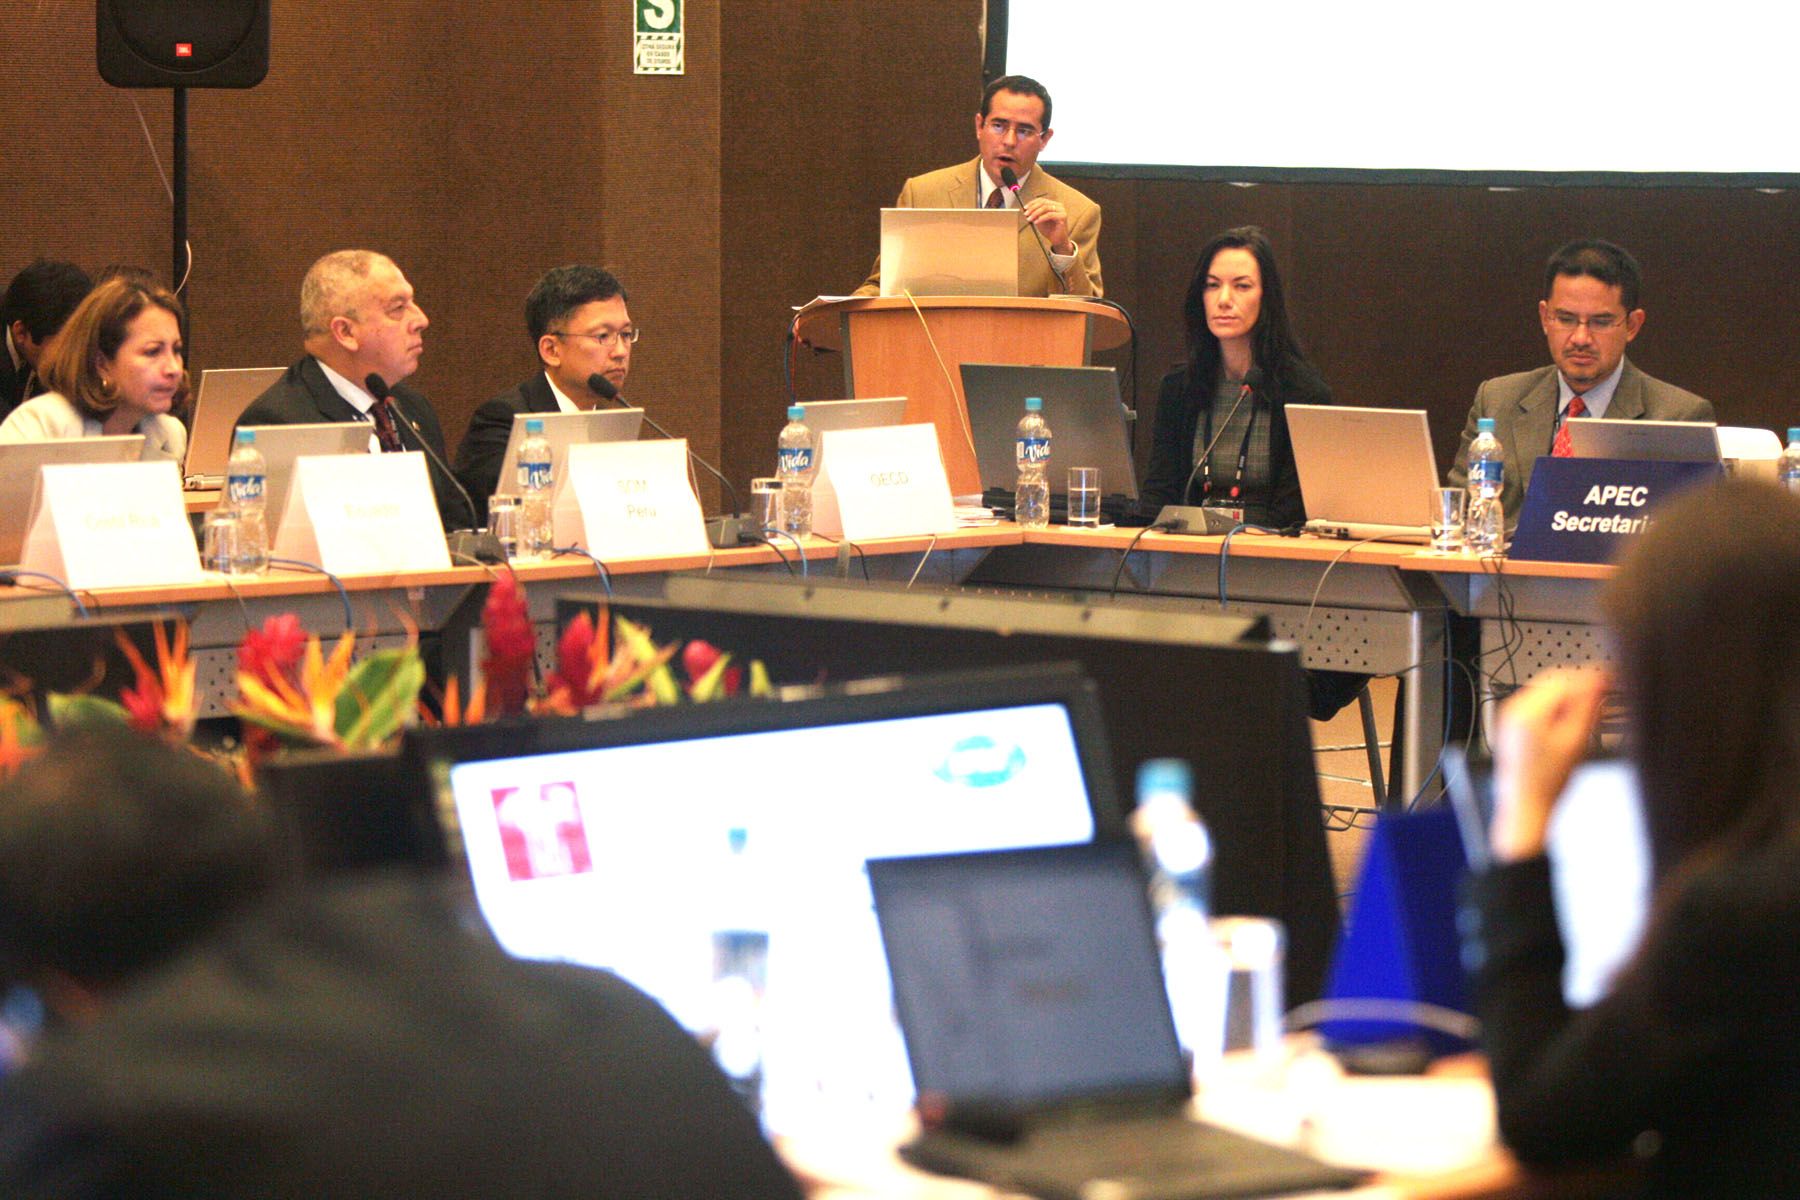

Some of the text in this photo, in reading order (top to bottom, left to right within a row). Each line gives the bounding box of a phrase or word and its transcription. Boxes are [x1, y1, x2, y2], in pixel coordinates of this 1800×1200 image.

[869, 471, 909, 487] OECD
[1582, 485, 1649, 507] APEC
[1551, 510, 1653, 534] Secretari
